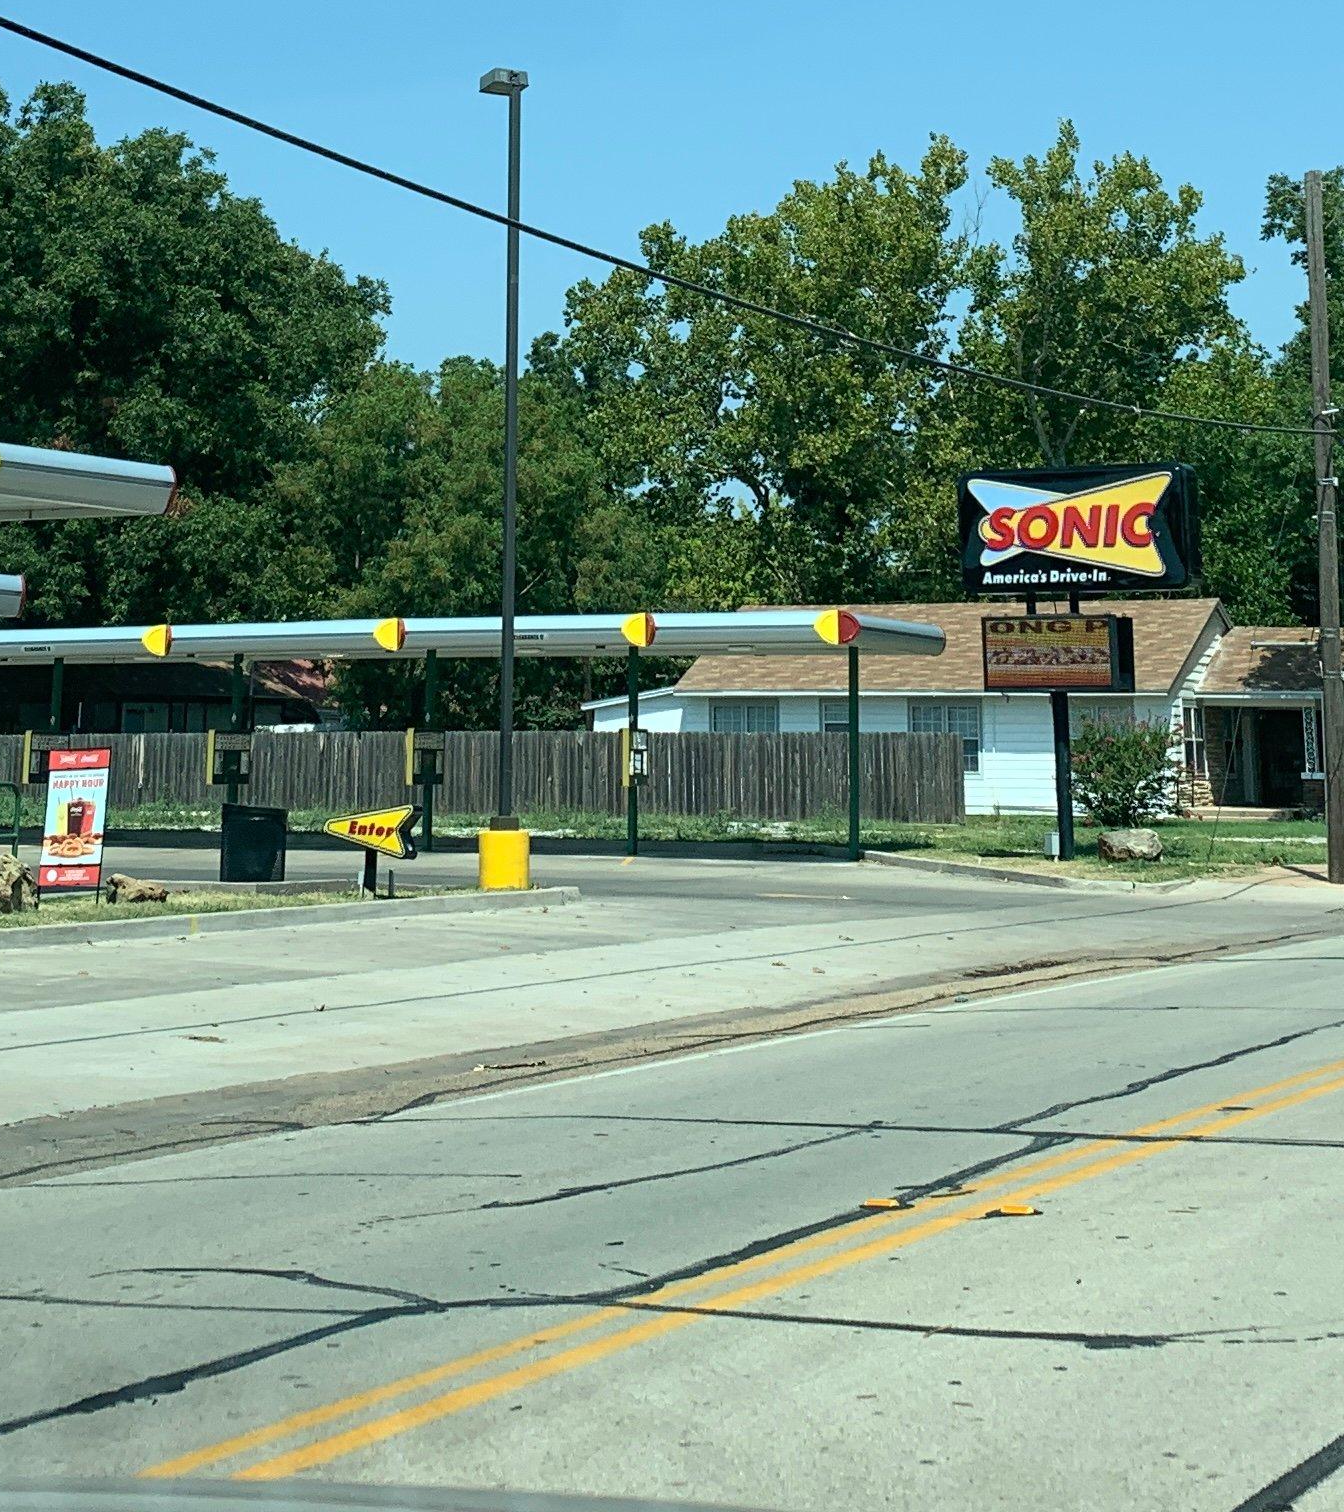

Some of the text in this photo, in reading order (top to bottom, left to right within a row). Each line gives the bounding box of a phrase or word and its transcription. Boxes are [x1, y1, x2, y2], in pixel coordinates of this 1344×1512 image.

[986, 502, 1157, 552] SONIC
[982, 569, 1047, 585] America's
[348, 820, 396, 838] Enter
